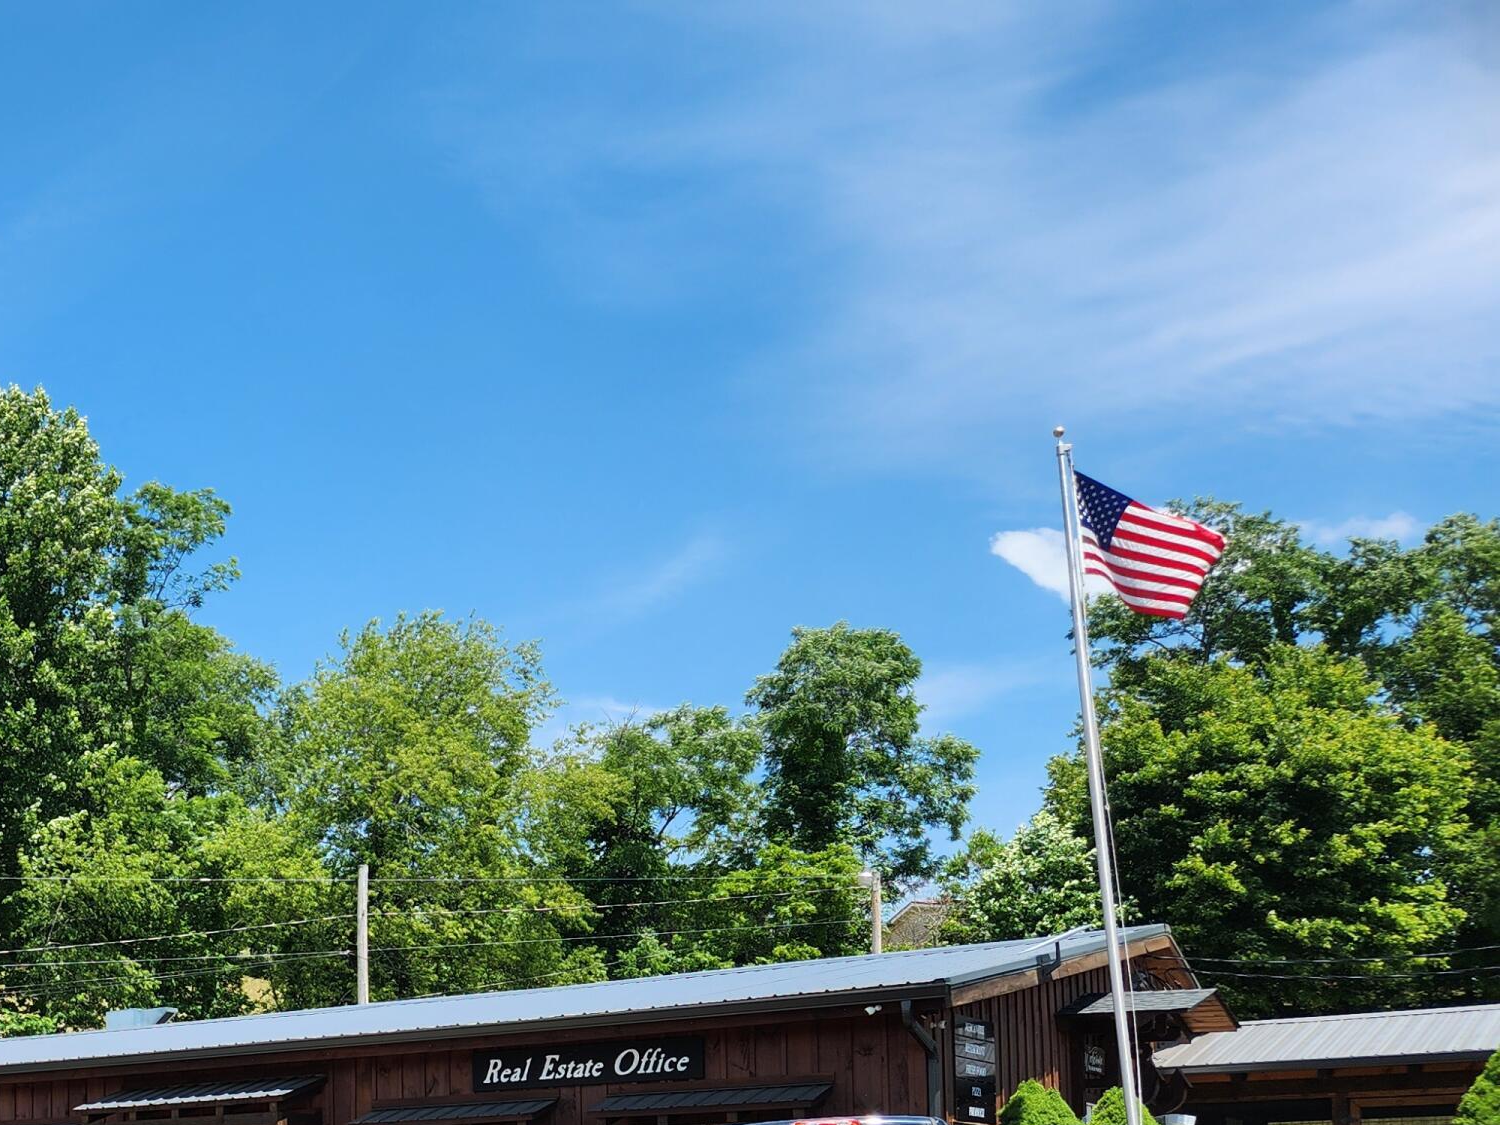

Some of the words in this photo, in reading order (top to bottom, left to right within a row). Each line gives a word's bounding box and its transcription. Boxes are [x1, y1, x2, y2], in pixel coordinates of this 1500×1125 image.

[483, 1057, 532, 1084] Real
[539, 1054, 604, 1080] Estate
[614, 1048, 690, 1076] Office
